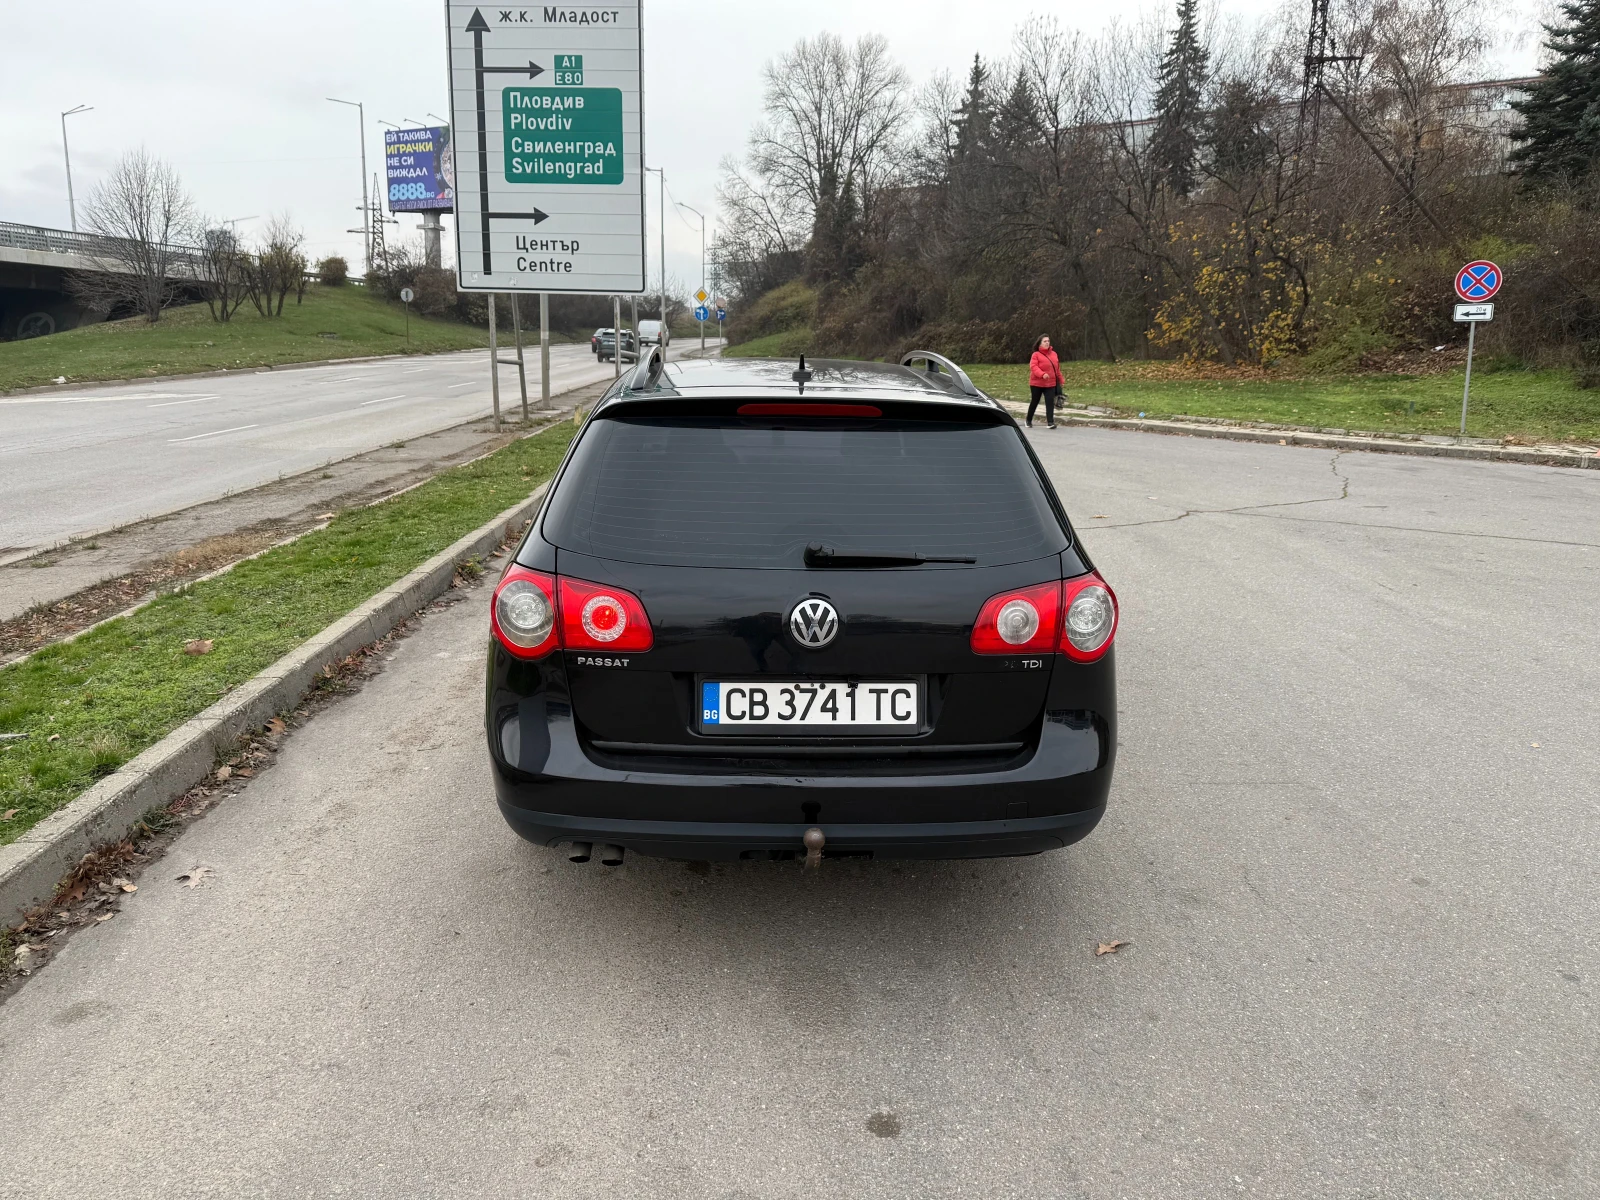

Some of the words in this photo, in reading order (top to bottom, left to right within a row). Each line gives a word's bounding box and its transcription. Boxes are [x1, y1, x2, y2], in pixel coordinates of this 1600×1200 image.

[499, 11, 534, 23] ж.к.
[544, 7, 619, 24] Младост
[556, 73, 581, 84] E80
[510, 92, 584, 110] Пловдив
[510, 114, 572, 130] Plovdiv
[386, 132, 397, 142] ЕЙ
[398, 131, 432, 140] ТАКИВА
[387, 142, 433, 154] ИГРАЧКИ
[511, 138, 616, 157] Свиленград
[388, 158, 399, 166] НЕ
[401, 157, 414, 165] СИ
[512, 158, 603, 178] Svilengrad
[388, 167, 428, 178] ВИЖДАЛ
[516, 236, 579, 254] Център
[517, 257, 572, 272] Centre
[578, 657, 630, 667] PASSAT
[1022, 660, 1043, 669] TDI
[777, 687, 858, 722] 3741
[704, 710, 718, 720] BG
